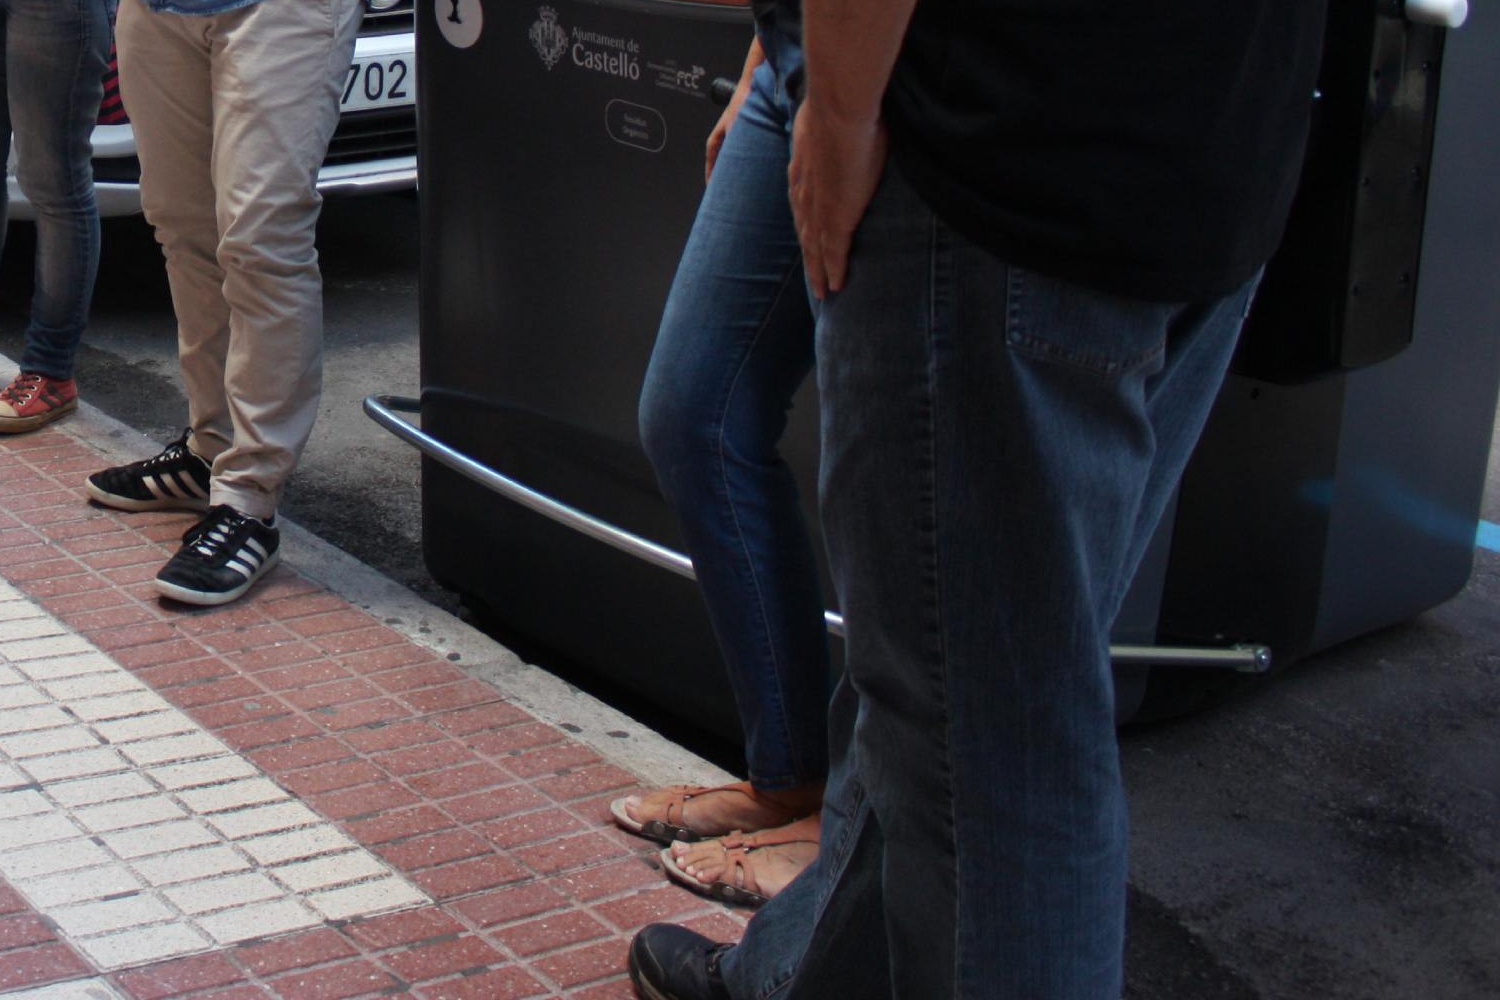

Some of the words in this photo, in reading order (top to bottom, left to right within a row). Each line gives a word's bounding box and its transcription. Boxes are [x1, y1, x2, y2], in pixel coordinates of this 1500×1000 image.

[572, 26, 625, 51] Ajuntament
[627, 39, 639, 53] de
[572, 42, 640, 80] Castelló
[341, 59, 407, 104] 702
[676, 70, 700, 89] FCC
